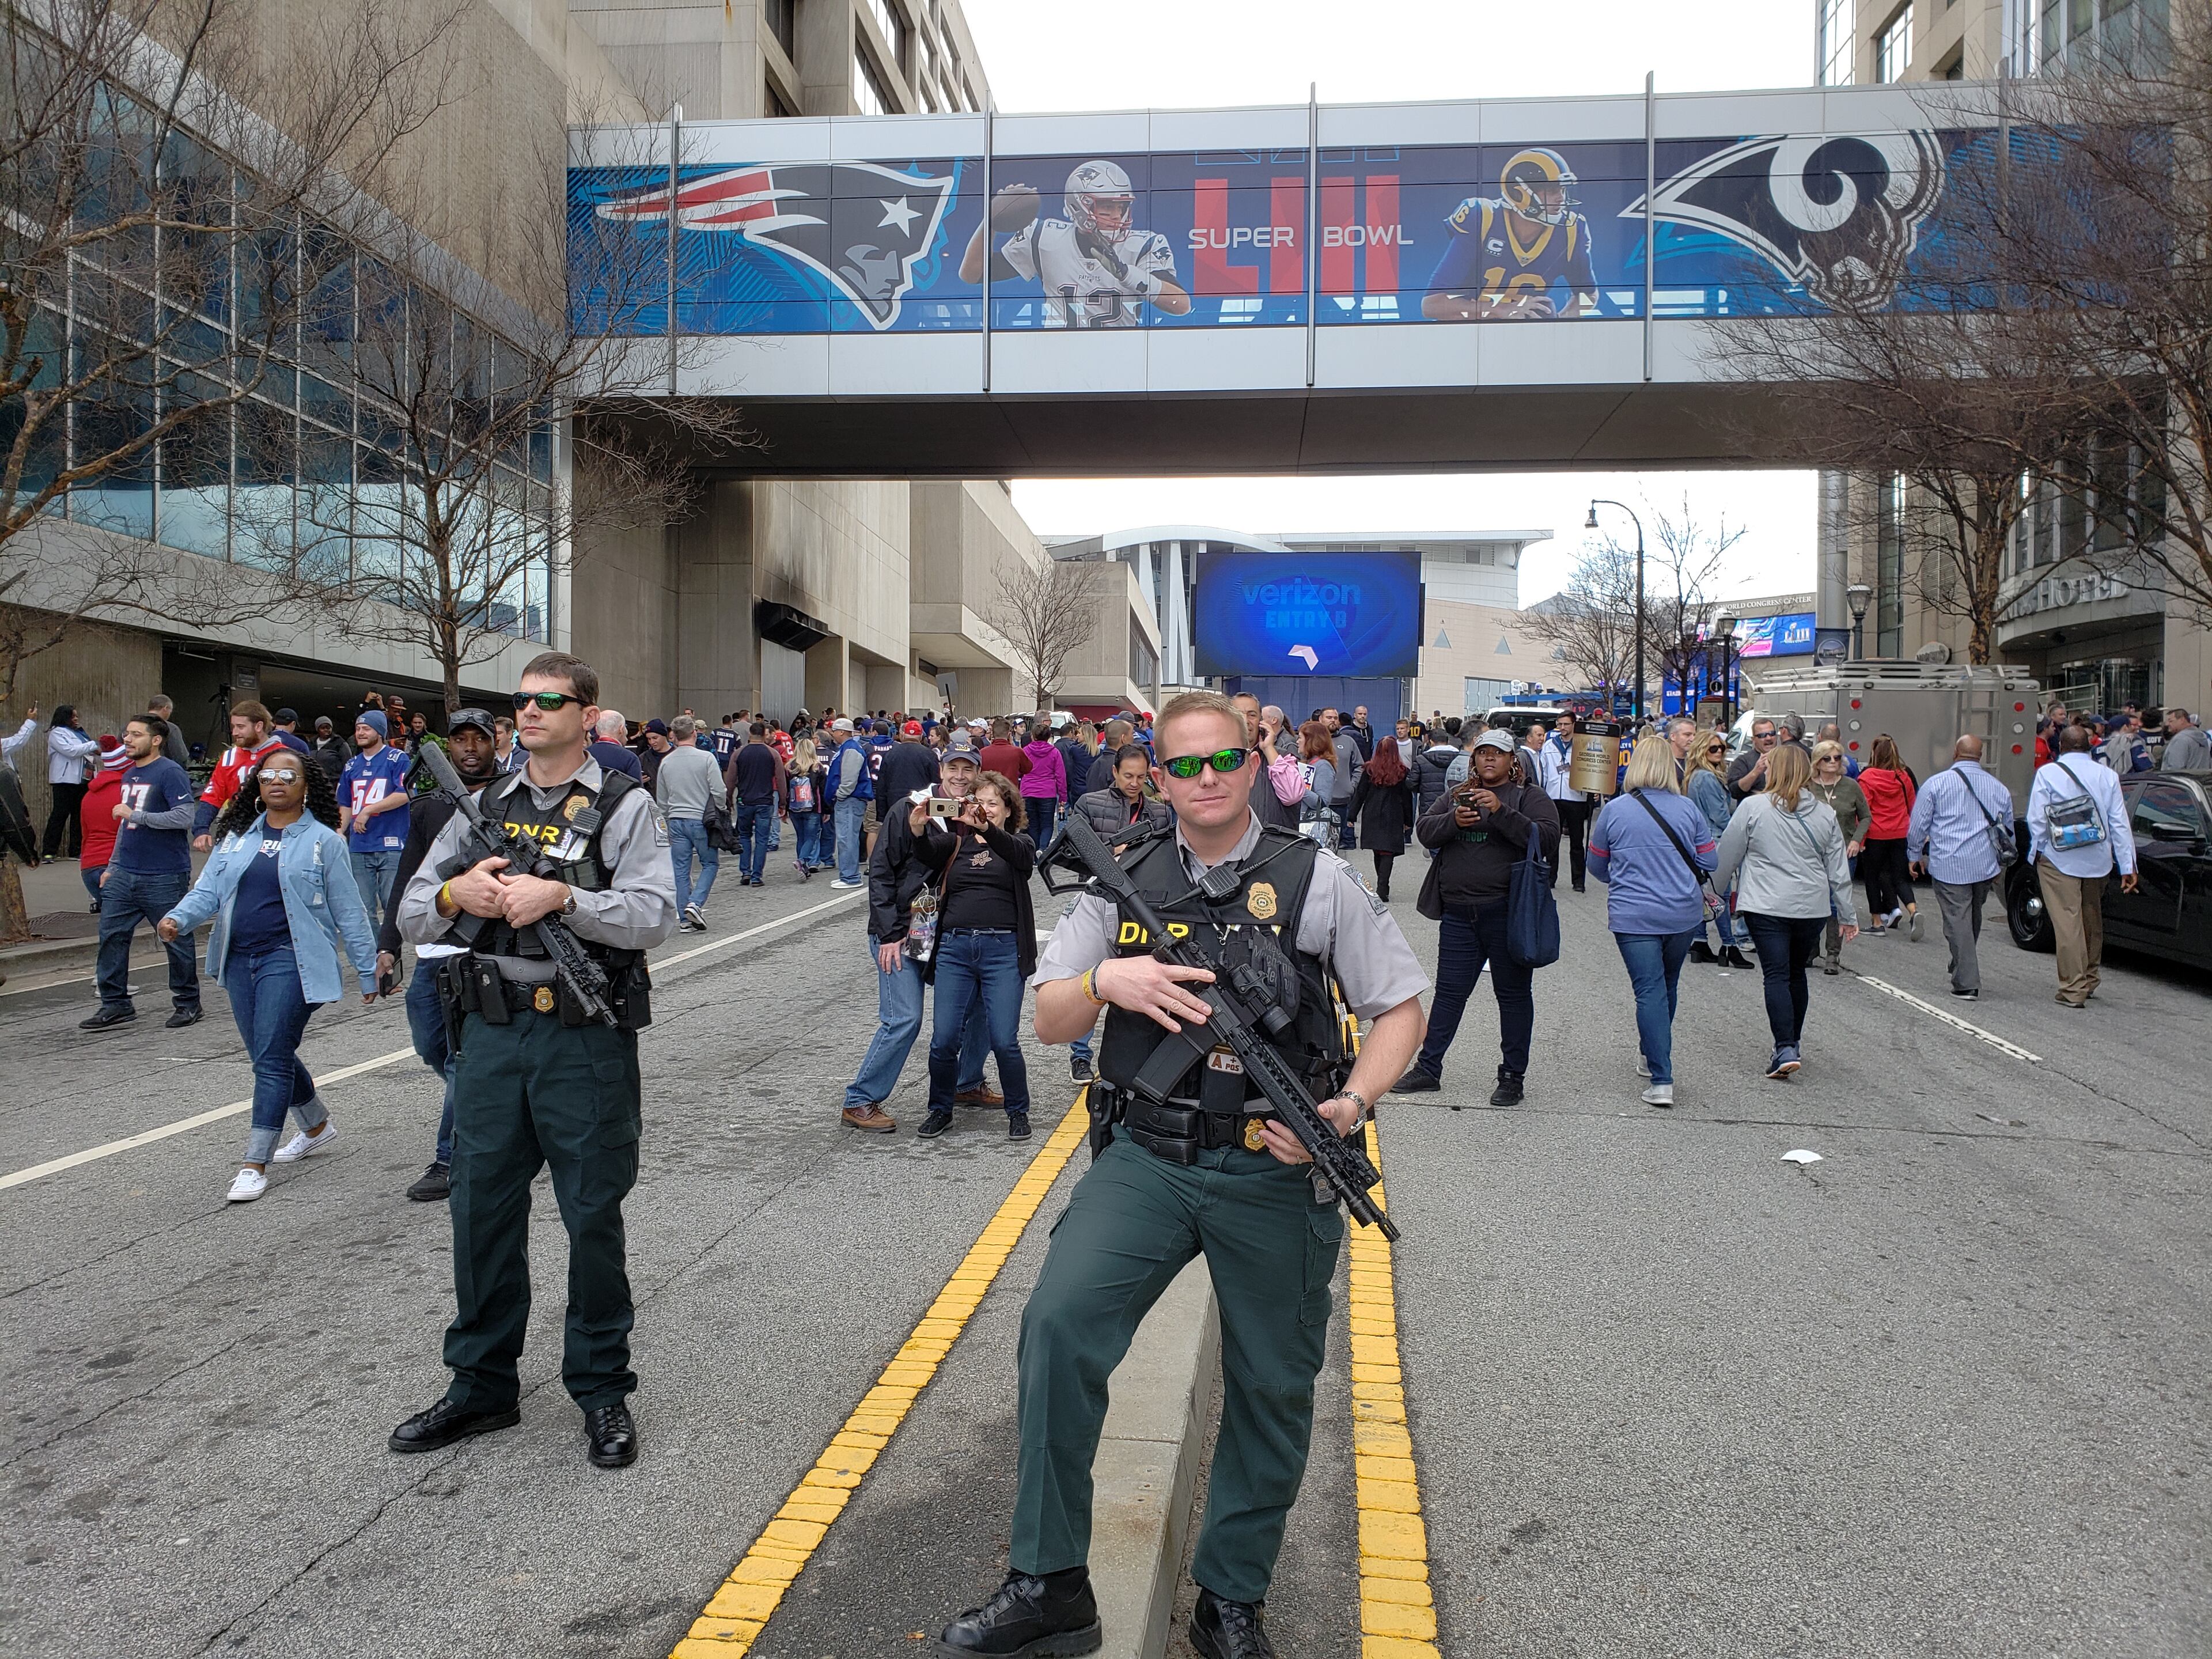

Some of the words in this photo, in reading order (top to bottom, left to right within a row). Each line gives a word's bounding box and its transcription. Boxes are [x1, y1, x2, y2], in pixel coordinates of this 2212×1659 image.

[1188, 227, 1294, 249] SUPER
[1324, 225, 1413, 248] BOWL
[1058, 283, 1123, 328] 12
[1242, 578, 1360, 605] verizon
[1747, 599, 1782, 608] CONGRESS
[1783, 596, 1812, 604] CENTER
[1266, 611, 1330, 628] ENTRY
[1410, 726, 1420, 737] 10
[717, 738, 730, 753] 11
[352, 779, 387, 816] 54
[505, 822, 560, 843] DNR
[1211, 1054, 1222, 1069] A
[1225, 1063, 1240, 1071] POS
